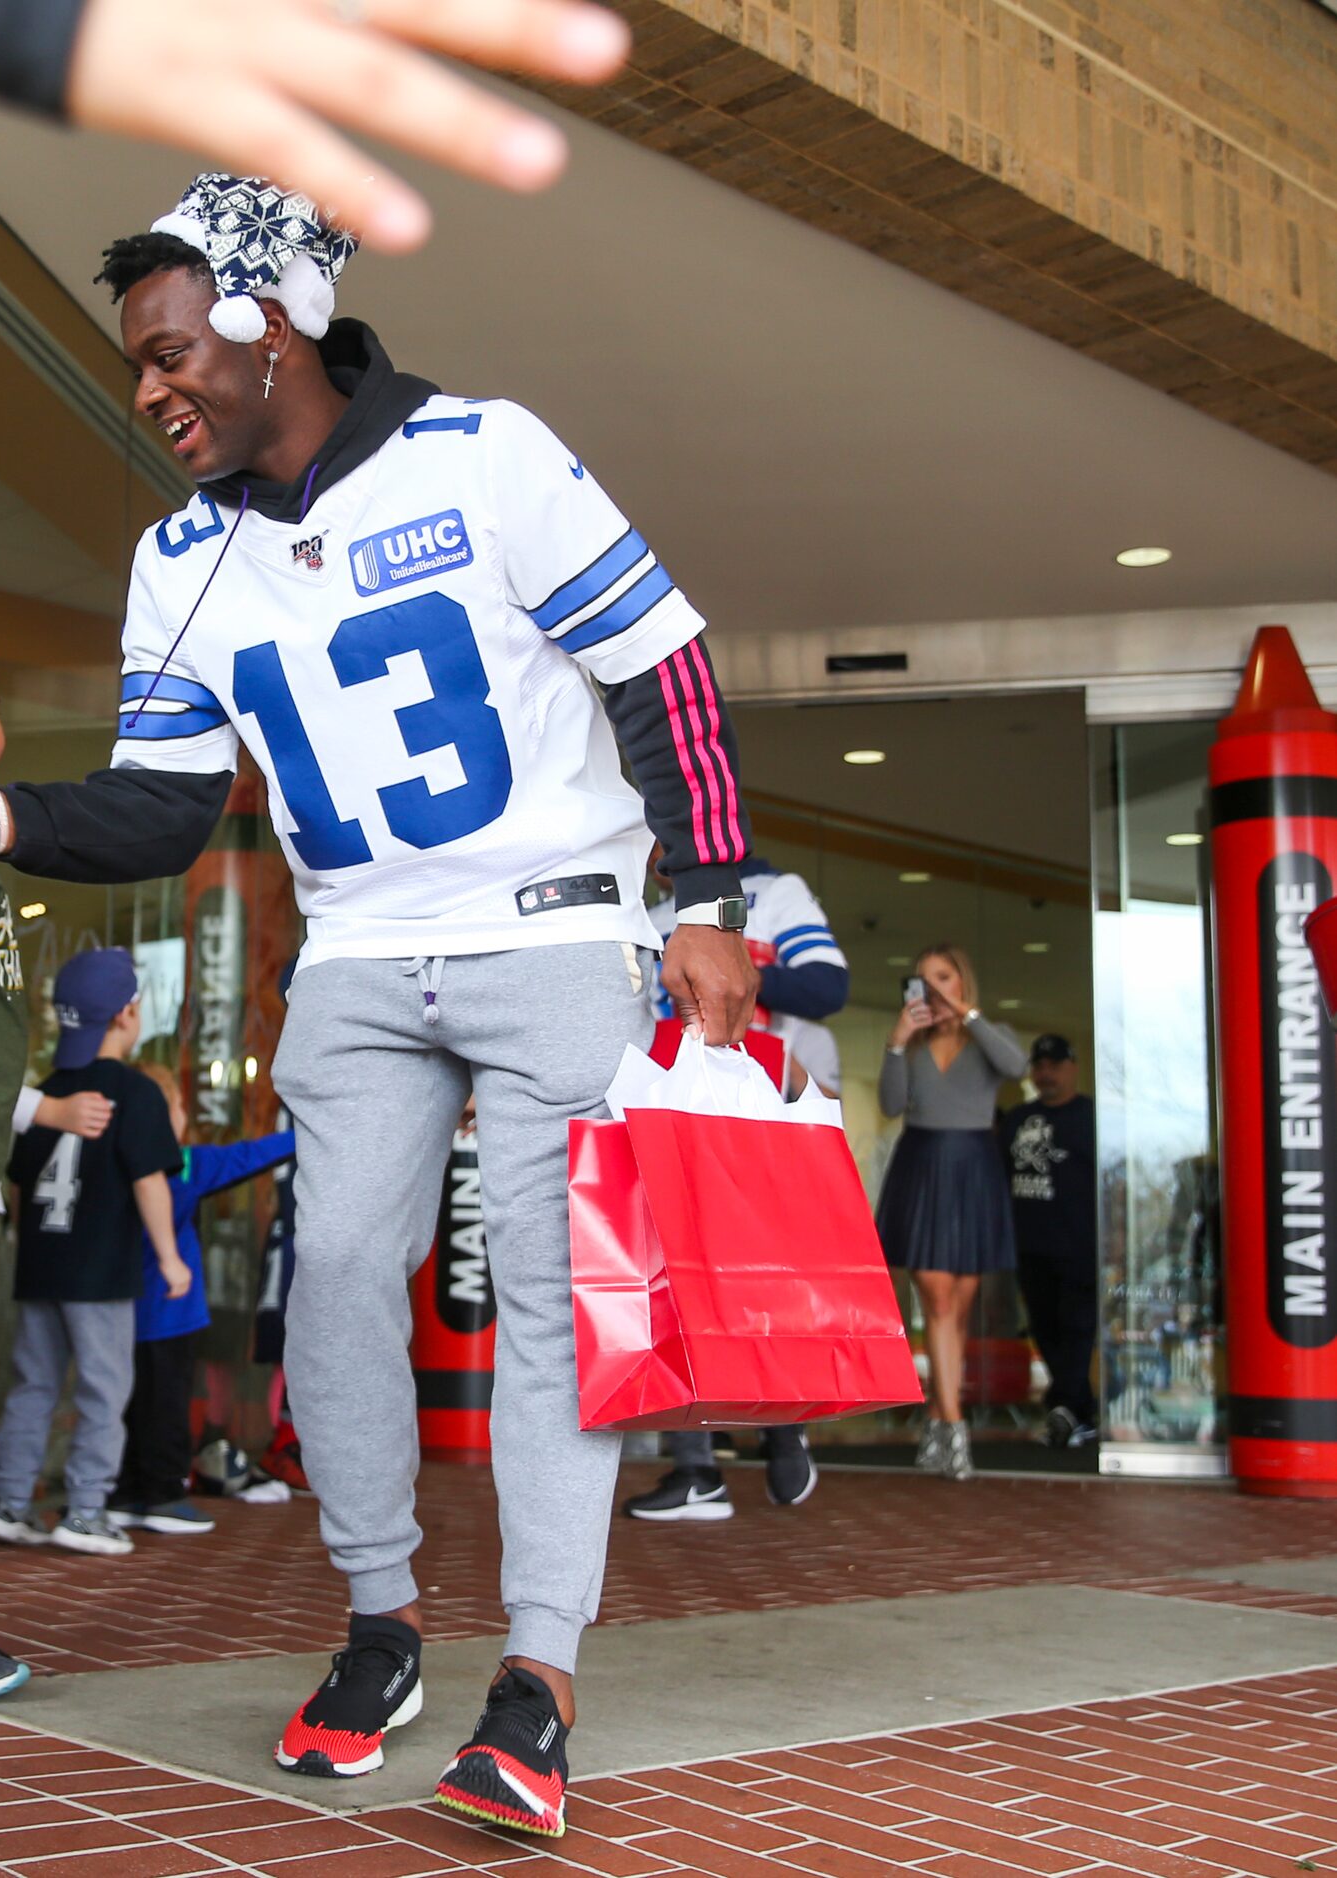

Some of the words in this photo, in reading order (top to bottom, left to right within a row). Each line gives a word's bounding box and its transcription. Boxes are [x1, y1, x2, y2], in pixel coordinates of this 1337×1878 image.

[382, 518, 462, 565] UHC
[232, 591, 513, 871] 13
[1275, 882, 1323, 1150] ENTRANCE
[32, 1132, 83, 1234] 4
[449, 1167, 487, 1303] MAIN
[1282, 1171, 1327, 1316] MAIN
